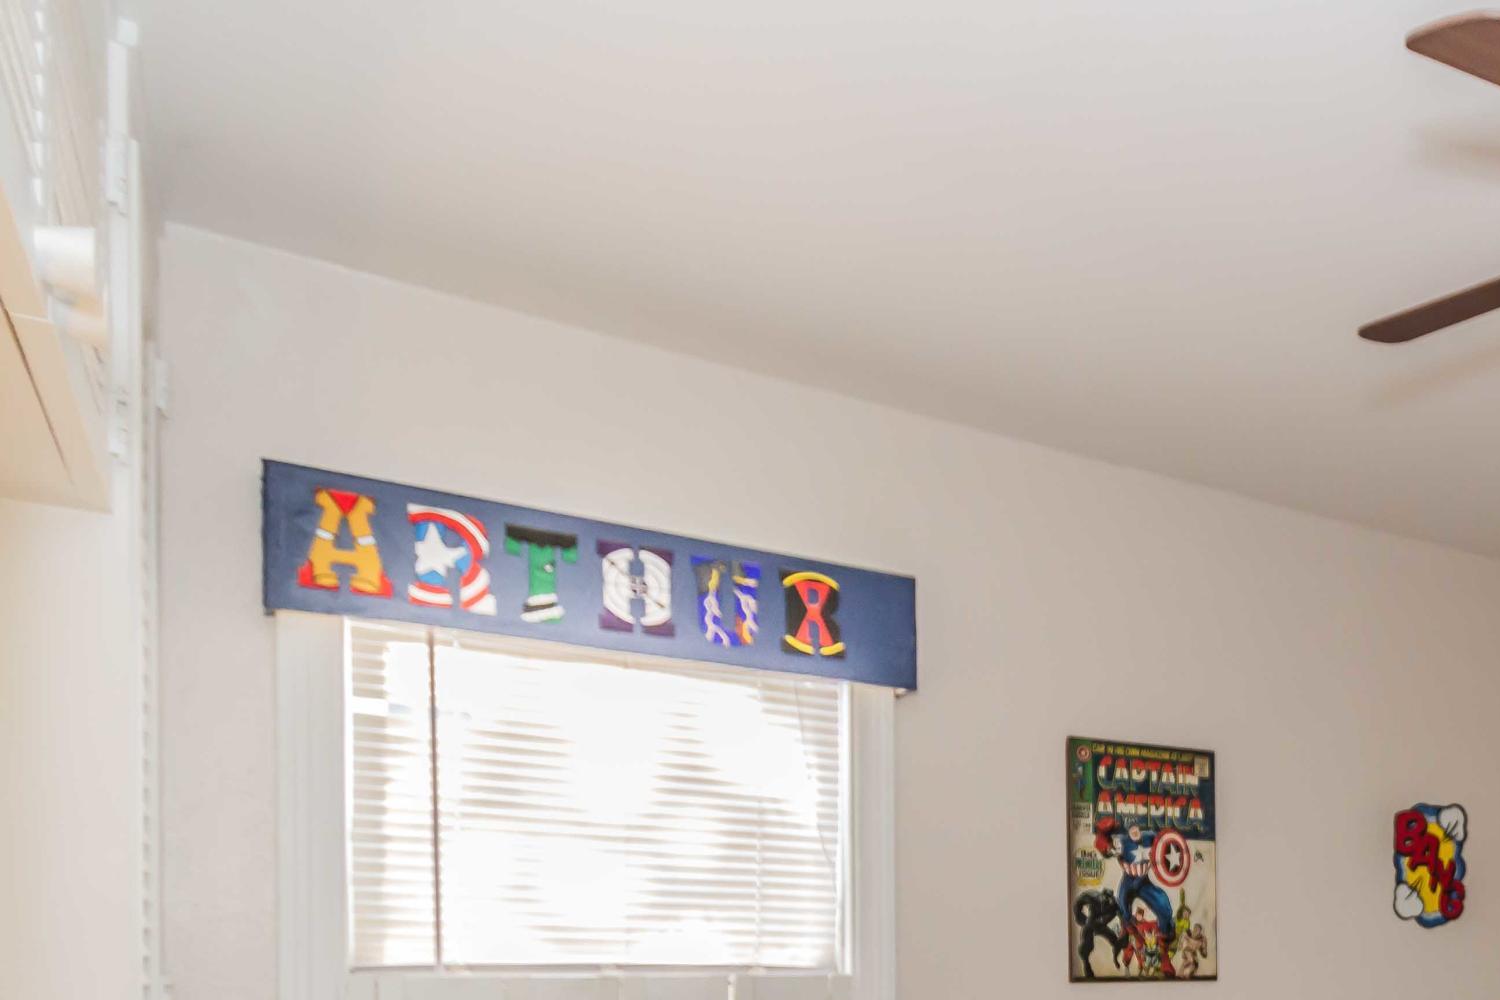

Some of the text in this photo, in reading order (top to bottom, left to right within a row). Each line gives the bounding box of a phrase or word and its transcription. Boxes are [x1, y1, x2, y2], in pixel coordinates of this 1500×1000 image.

[298, 487, 848, 657] ARTHUR
[1094, 788, 1206, 832] AMERICA
[1096, 754, 1200, 800] CAPTAIN
[1394, 808, 1466, 920] BANG
